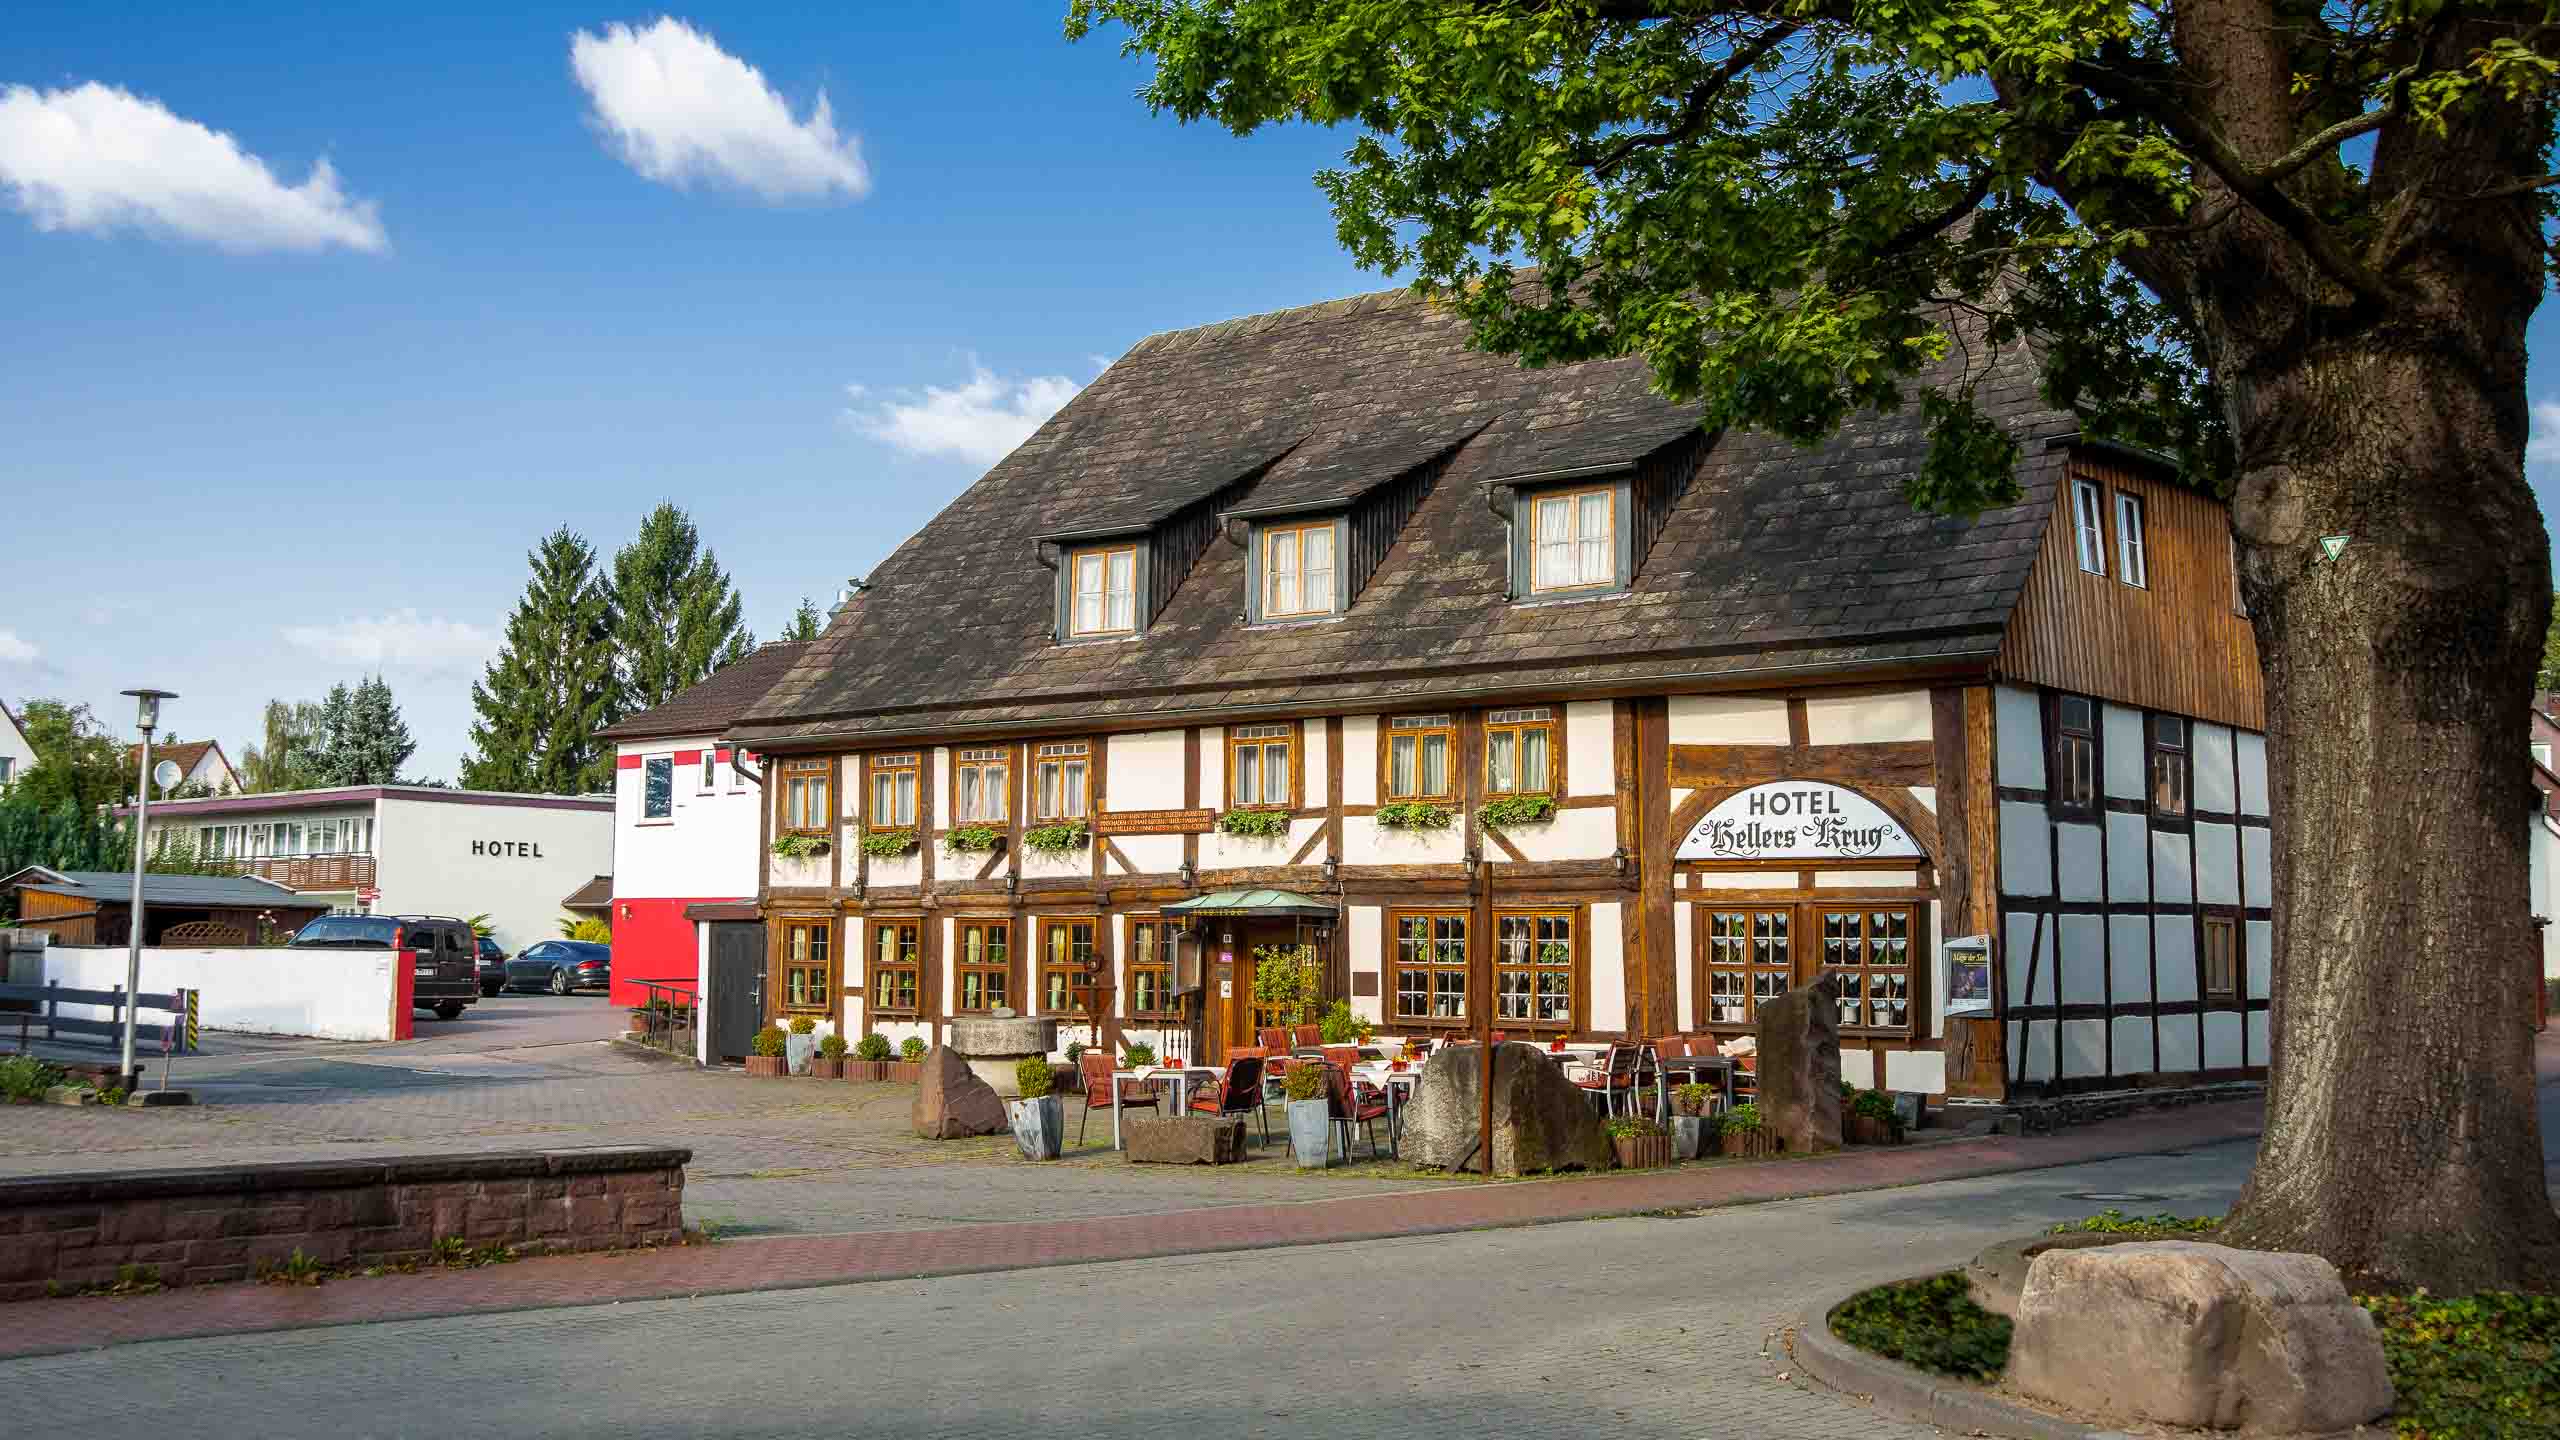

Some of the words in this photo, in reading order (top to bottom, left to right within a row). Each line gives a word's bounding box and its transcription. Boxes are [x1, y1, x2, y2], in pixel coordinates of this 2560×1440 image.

[1750, 791, 1840, 816] HOTEL
[472, 839, 544, 858] HOTEL
[1699, 818, 1797, 857] Hellers
[1802, 816, 1893, 857] Krug
